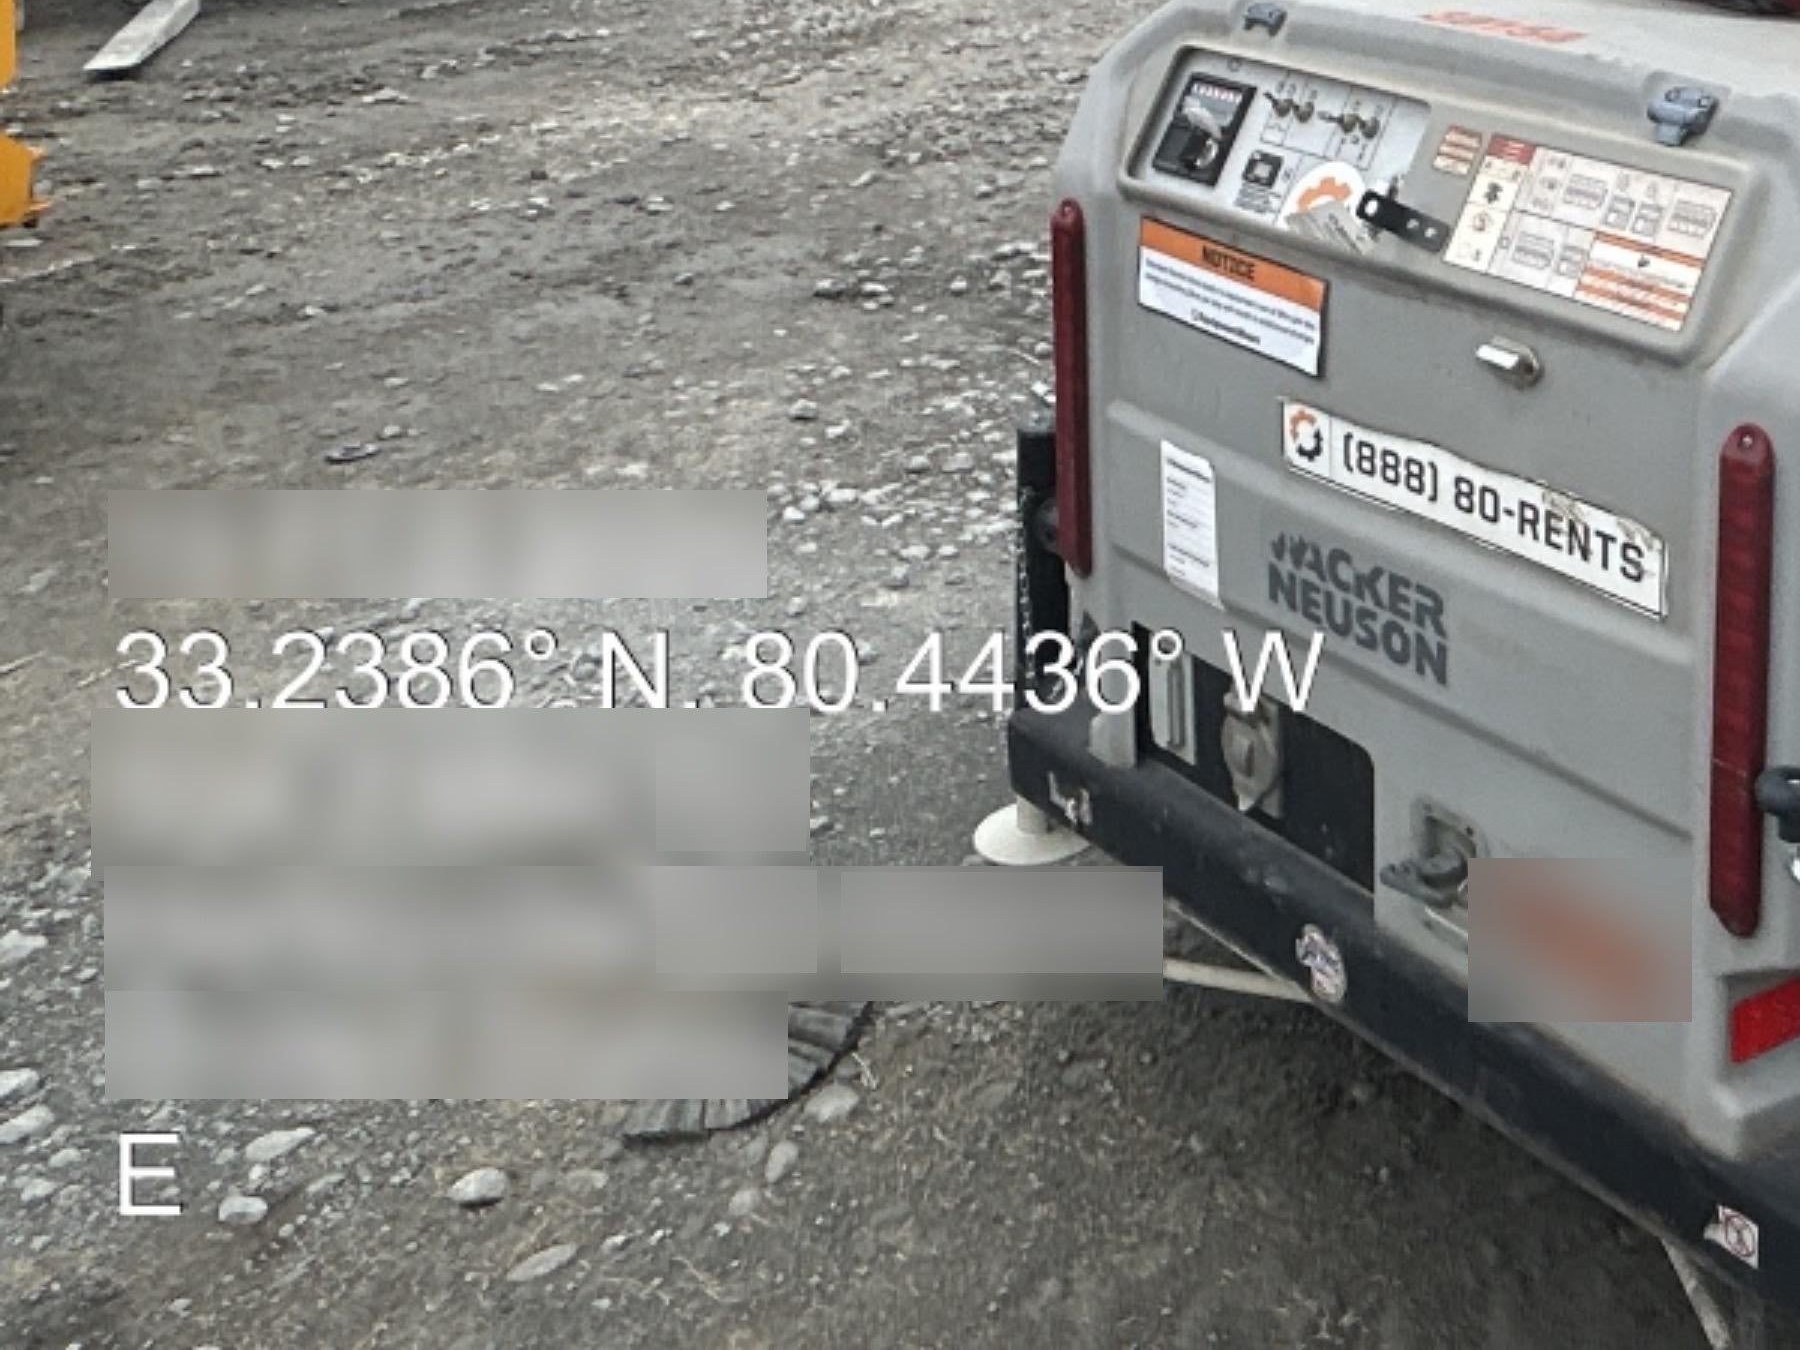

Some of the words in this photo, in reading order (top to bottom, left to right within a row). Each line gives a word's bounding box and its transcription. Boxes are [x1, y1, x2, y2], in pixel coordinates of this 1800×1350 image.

[1343, 432, 1438, 502] (888)
[1454, 475, 1646, 583] 80-RENTS
[1268, 561, 1448, 686] NEUSON
